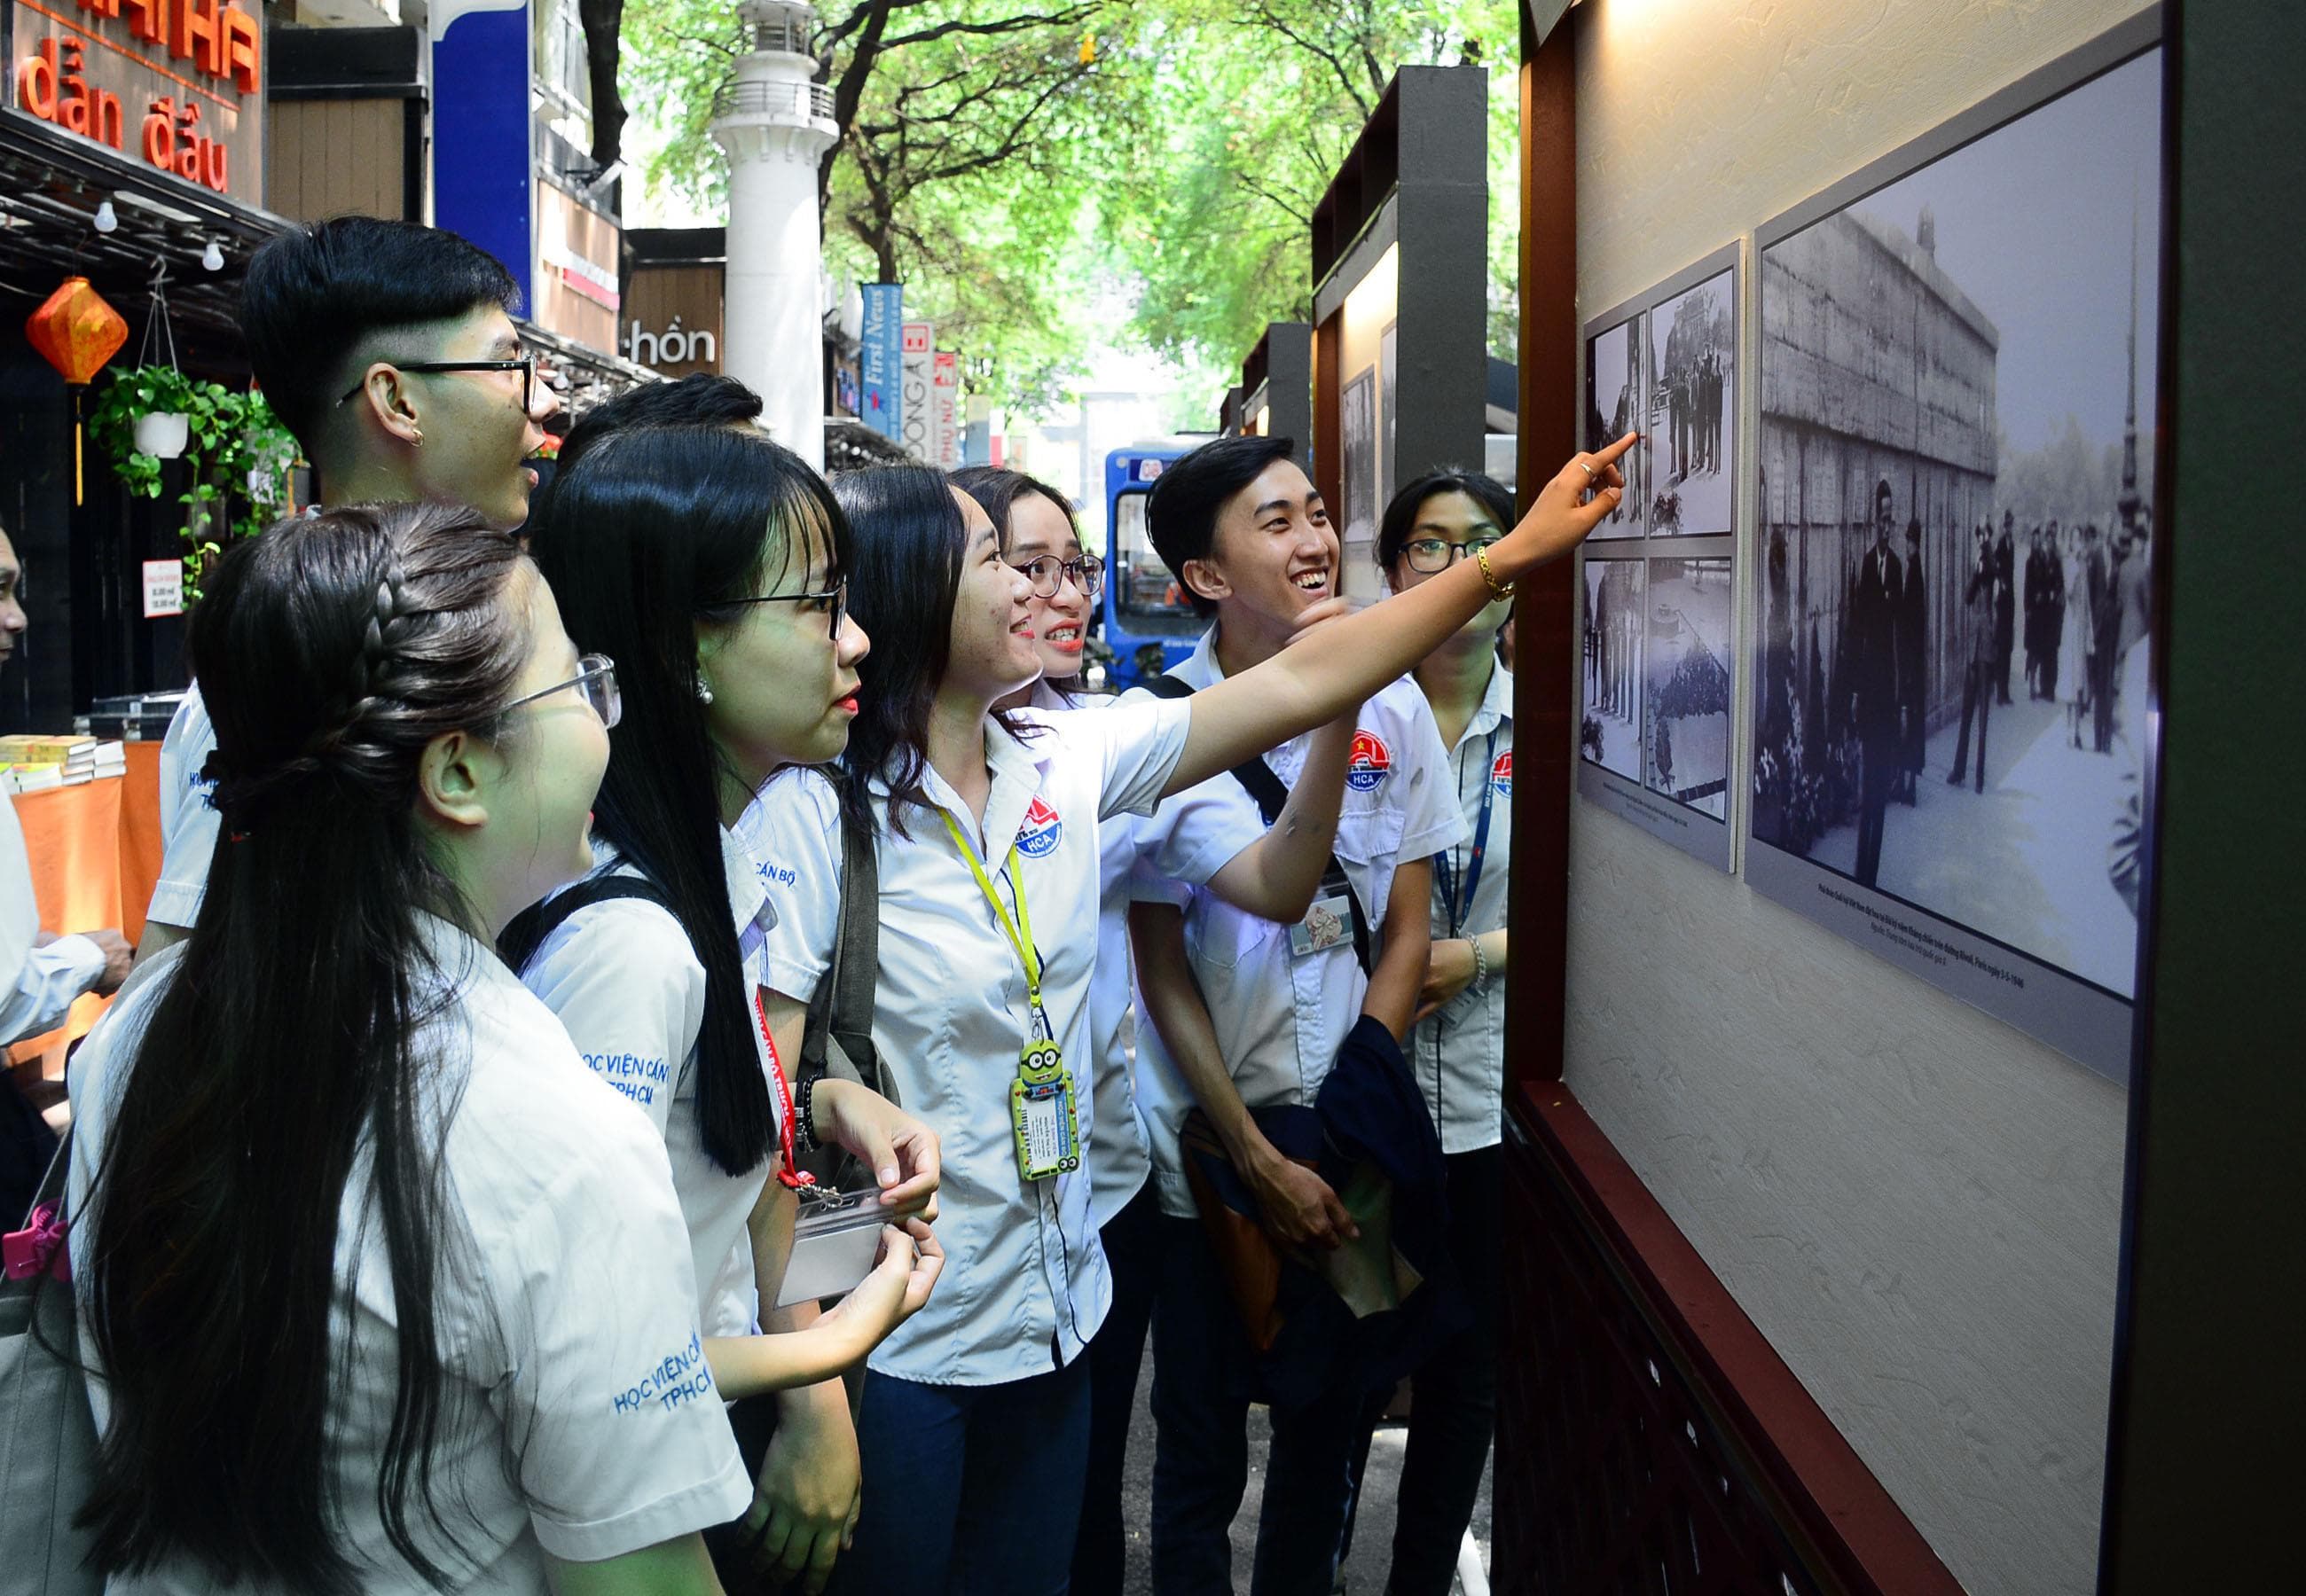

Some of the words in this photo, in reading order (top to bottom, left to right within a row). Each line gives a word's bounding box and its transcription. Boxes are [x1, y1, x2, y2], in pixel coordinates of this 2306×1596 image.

[20, 35, 122, 151] dẫn
[142, 97, 228, 193] đầu
[866, 289, 884, 337] News
[624, 315, 715, 365] hồn
[866, 342, 883, 386] First
[1353, 774, 1375, 785] HCA
[1026, 833, 1054, 852] HCA
[779, 869, 796, 888] BỘ
[607, 1053, 645, 1077] VIỆN
[614, 1379, 653, 1415] HỌC
[651, 1350, 691, 1390] VIỆN
